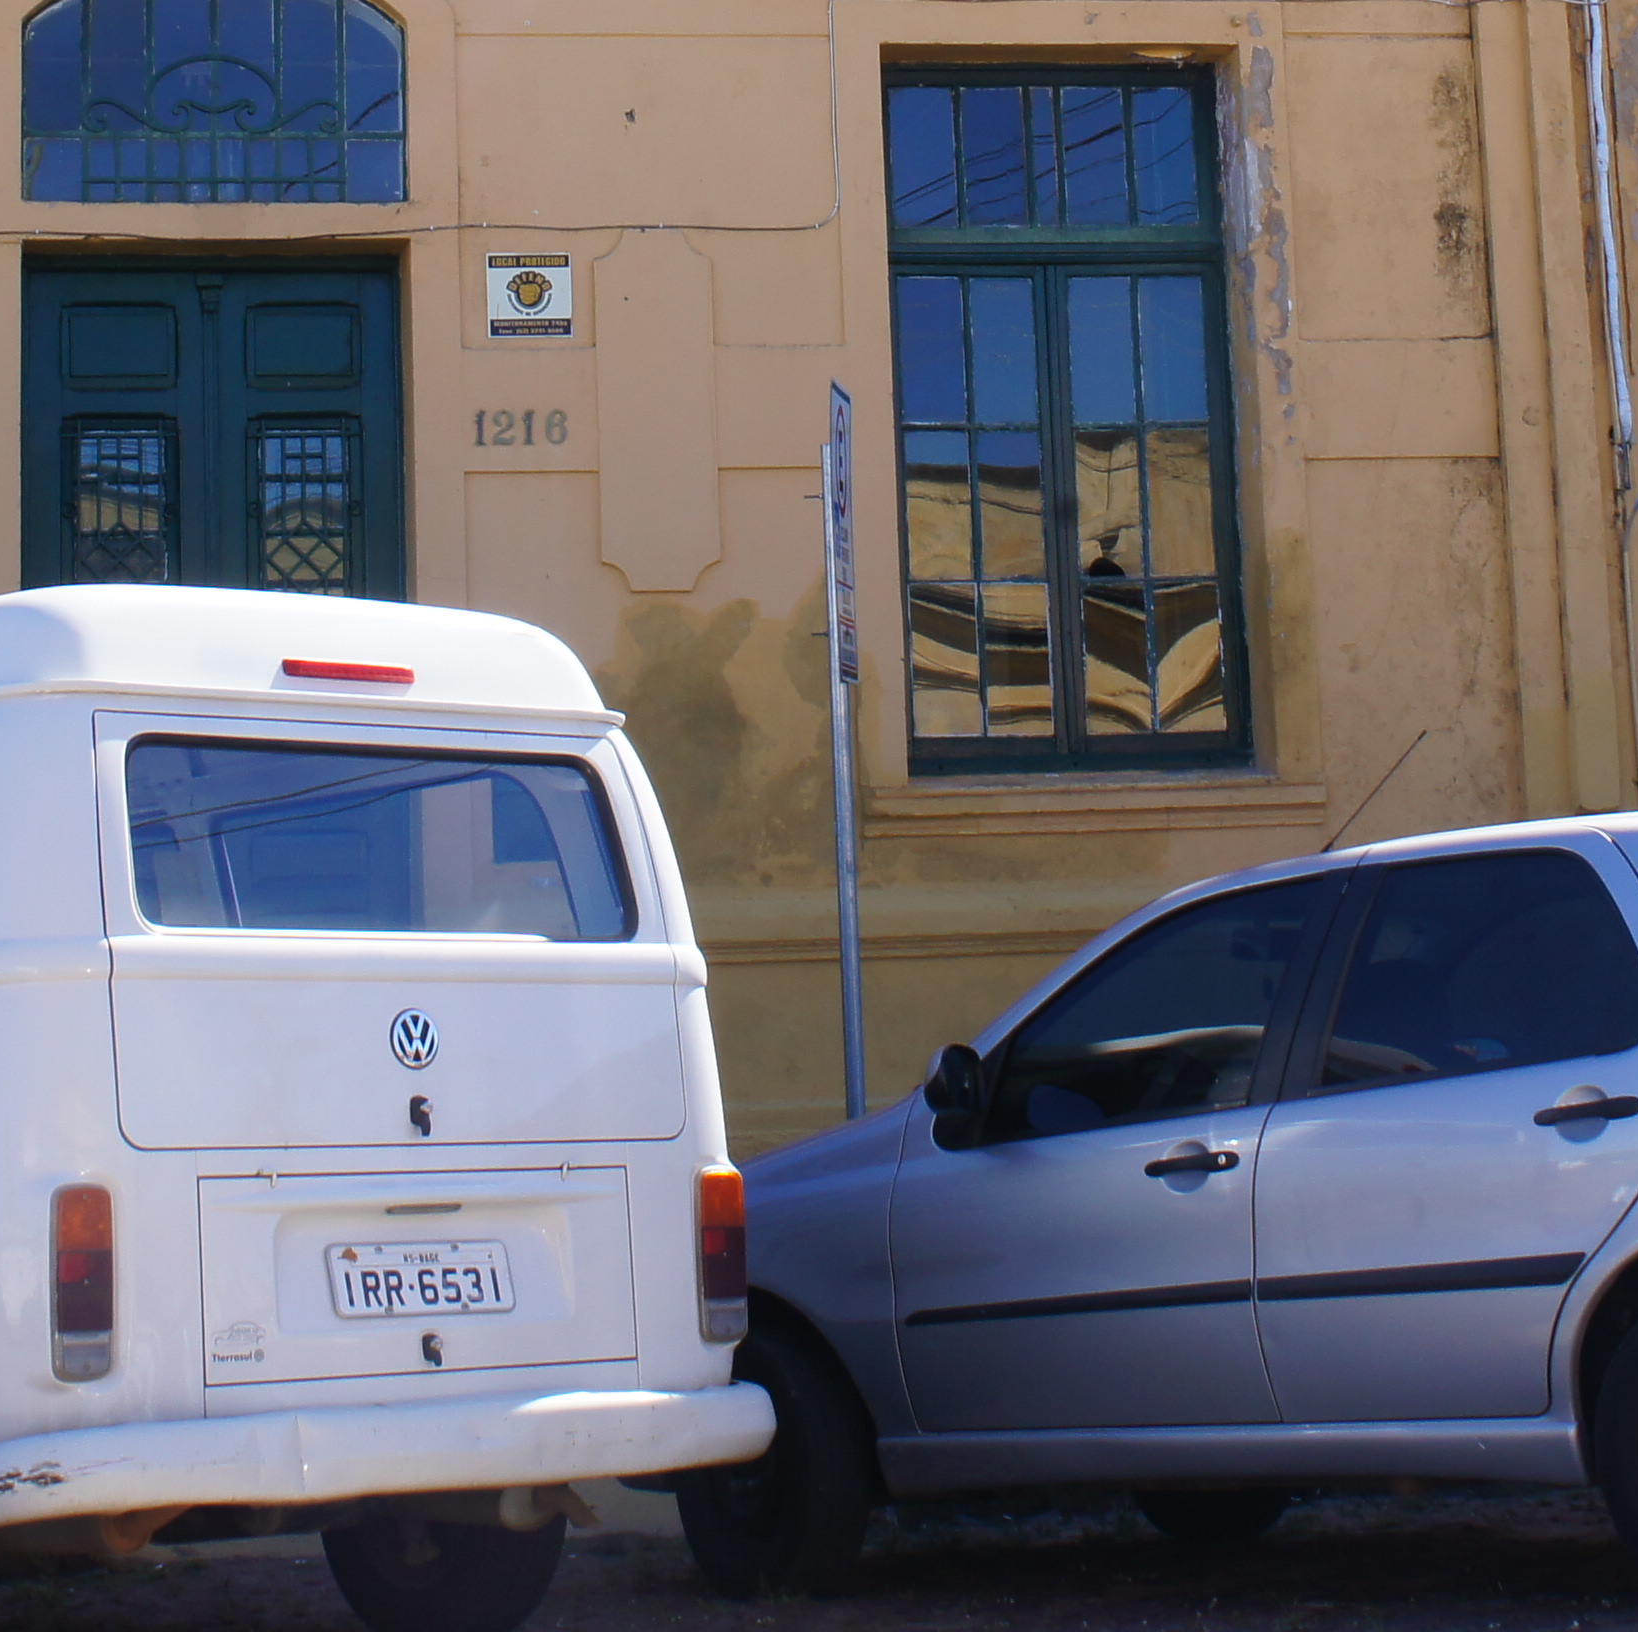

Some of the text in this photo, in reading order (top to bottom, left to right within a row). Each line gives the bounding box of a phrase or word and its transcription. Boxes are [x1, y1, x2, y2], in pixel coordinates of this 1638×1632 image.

[491, 256, 566, 267] LOCAL PROTEGIDO
[474, 409, 568, 447] 1216
